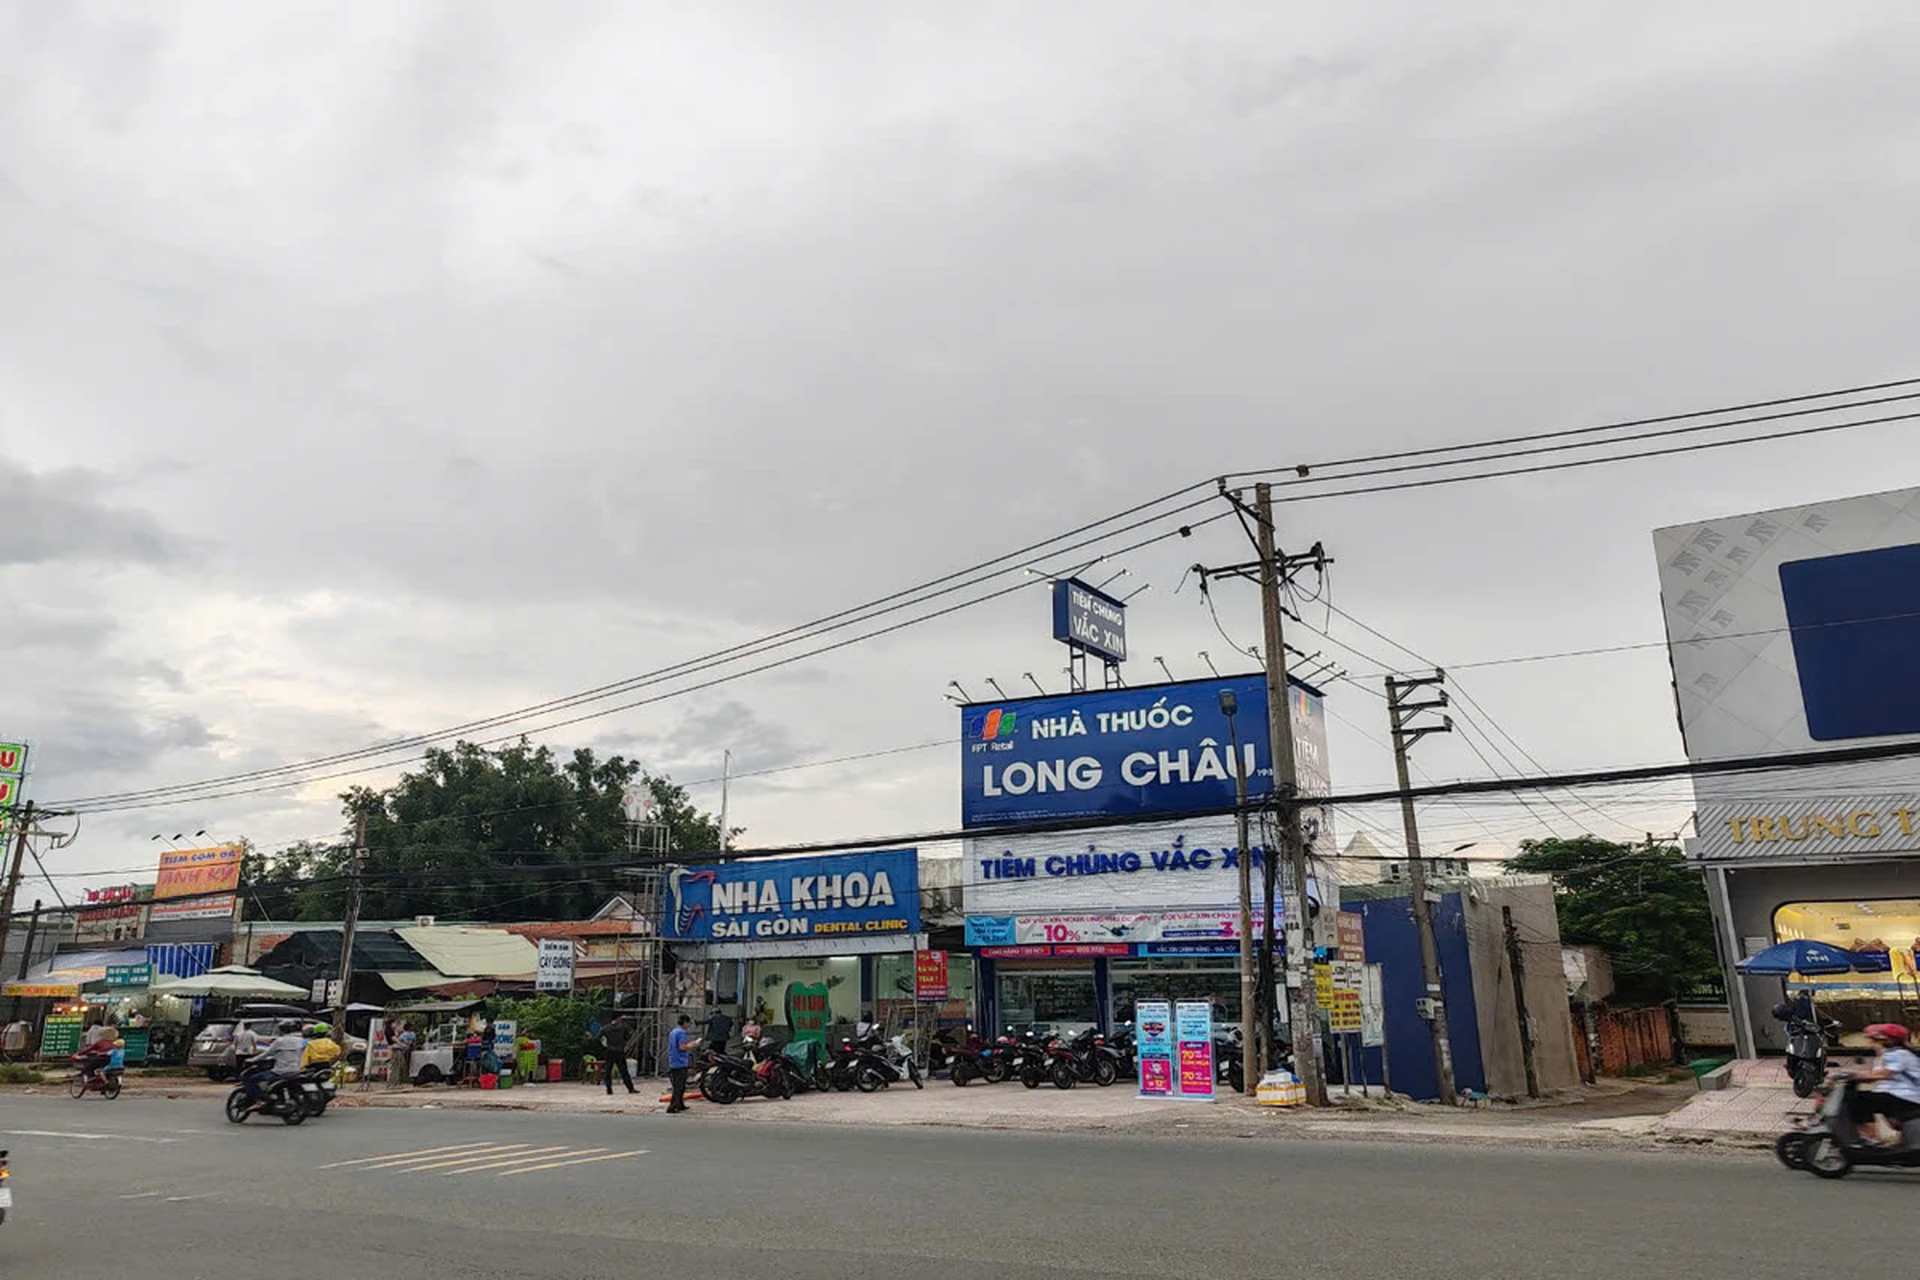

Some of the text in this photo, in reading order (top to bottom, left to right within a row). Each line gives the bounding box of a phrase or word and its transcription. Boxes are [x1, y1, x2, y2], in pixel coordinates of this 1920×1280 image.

[1073, 611, 1124, 655] VẮC XIN
[1031, 696, 1194, 740] NHÀ THUỐC
[971, 743, 987, 753] FPT
[983, 756, 1103, 797] LONG
[1120, 737, 1256, 787] CHÂU
[1725, 810, 1880, 844] TRUNG
[980, 836, 1273, 879] TIÊM CHỦNG VẮC XN
[711, 871, 895, 916] NHA KHOA
[711, 914, 908, 938] SÀI GÒN DENTAL CLINIC
